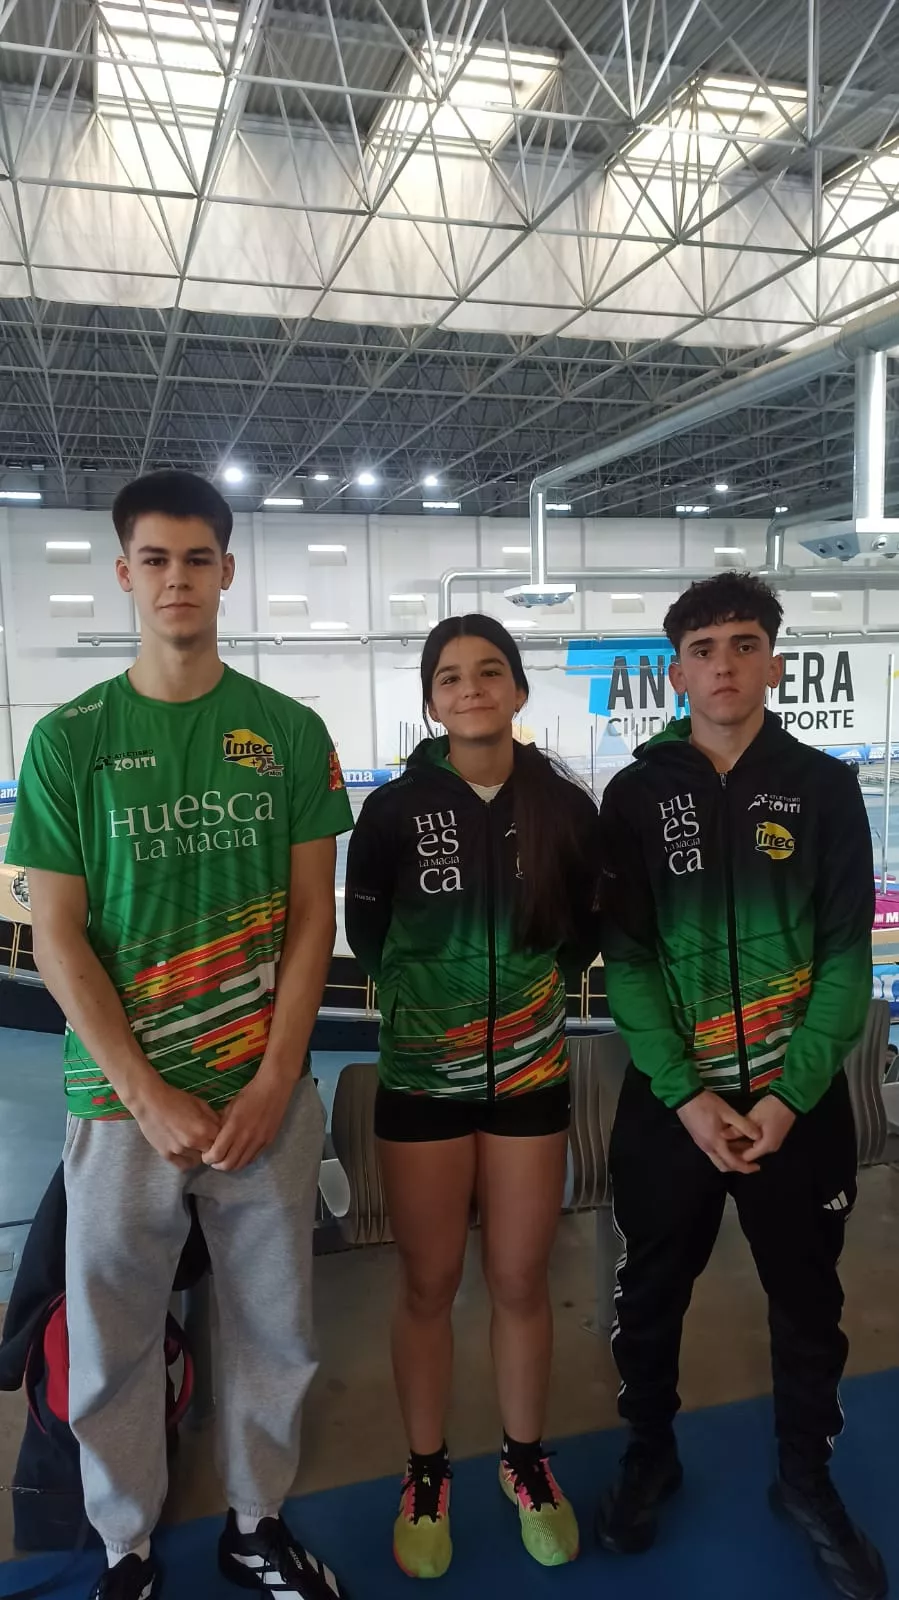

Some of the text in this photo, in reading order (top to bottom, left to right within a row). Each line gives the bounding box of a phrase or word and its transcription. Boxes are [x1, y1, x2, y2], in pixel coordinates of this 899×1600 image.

[606, 651, 855, 710] ANERA
[114, 756, 157, 771] ZOITI
[109, 790, 275, 839] Huesca
[412, 809, 458, 834] Hu
[134, 838, 169, 861] La
[416, 828, 460, 857] es
[419, 866, 464, 894] ca
